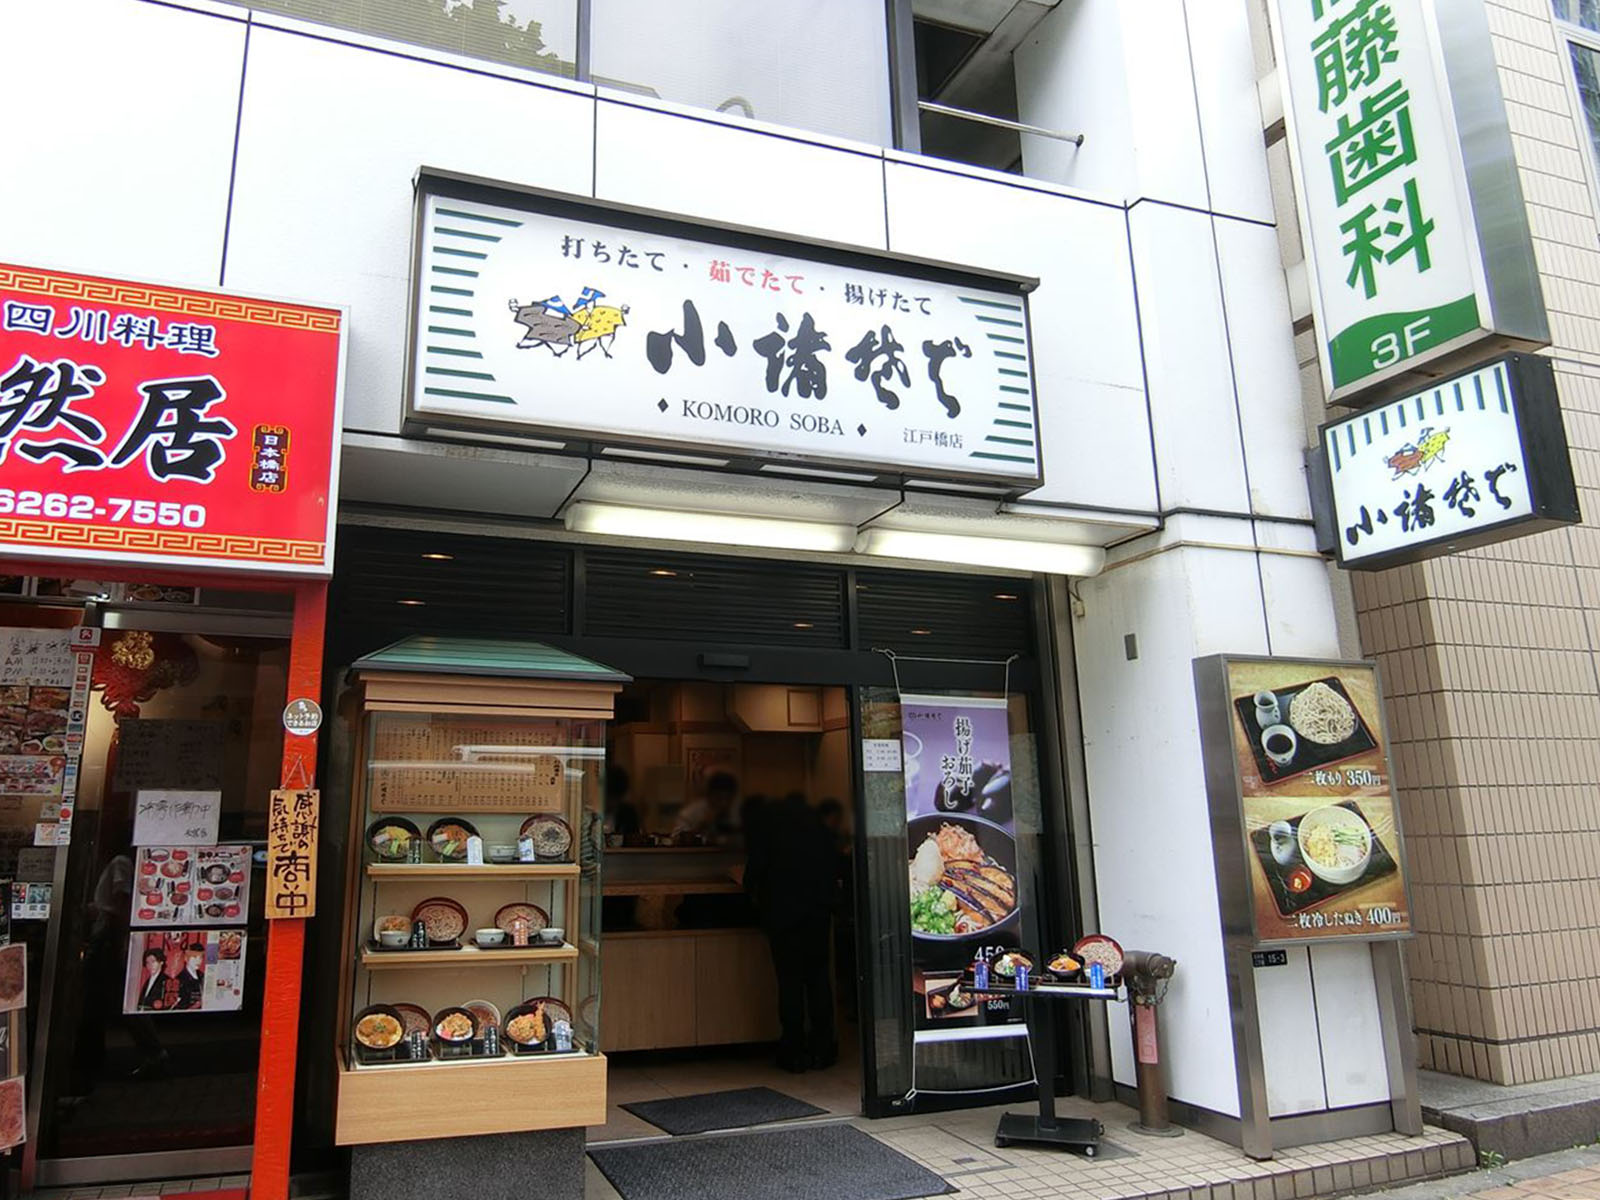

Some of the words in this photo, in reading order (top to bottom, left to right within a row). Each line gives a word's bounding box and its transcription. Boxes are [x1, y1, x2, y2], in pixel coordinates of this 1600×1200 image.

[1312, 0, 1434, 300] 藤歯科
[6, 304, 218, 356] 四川料理
[1371, 316, 1431, 370] 3F
[682, 400, 780, 429] KOMORO
[790, 413, 845, 436] SOBA
[903, 427, 964, 450] 江戸橋店
[258, 434, 281, 484] 日本橋店
[941, 754, 958, 808] おろし
[954, 716, 975, 796] 揚げ茄子
[1346, 770, 1382, 786] 350円
[291, 792, 318, 850] 感謝の
[1366, 907, 1401, 926] 400円
